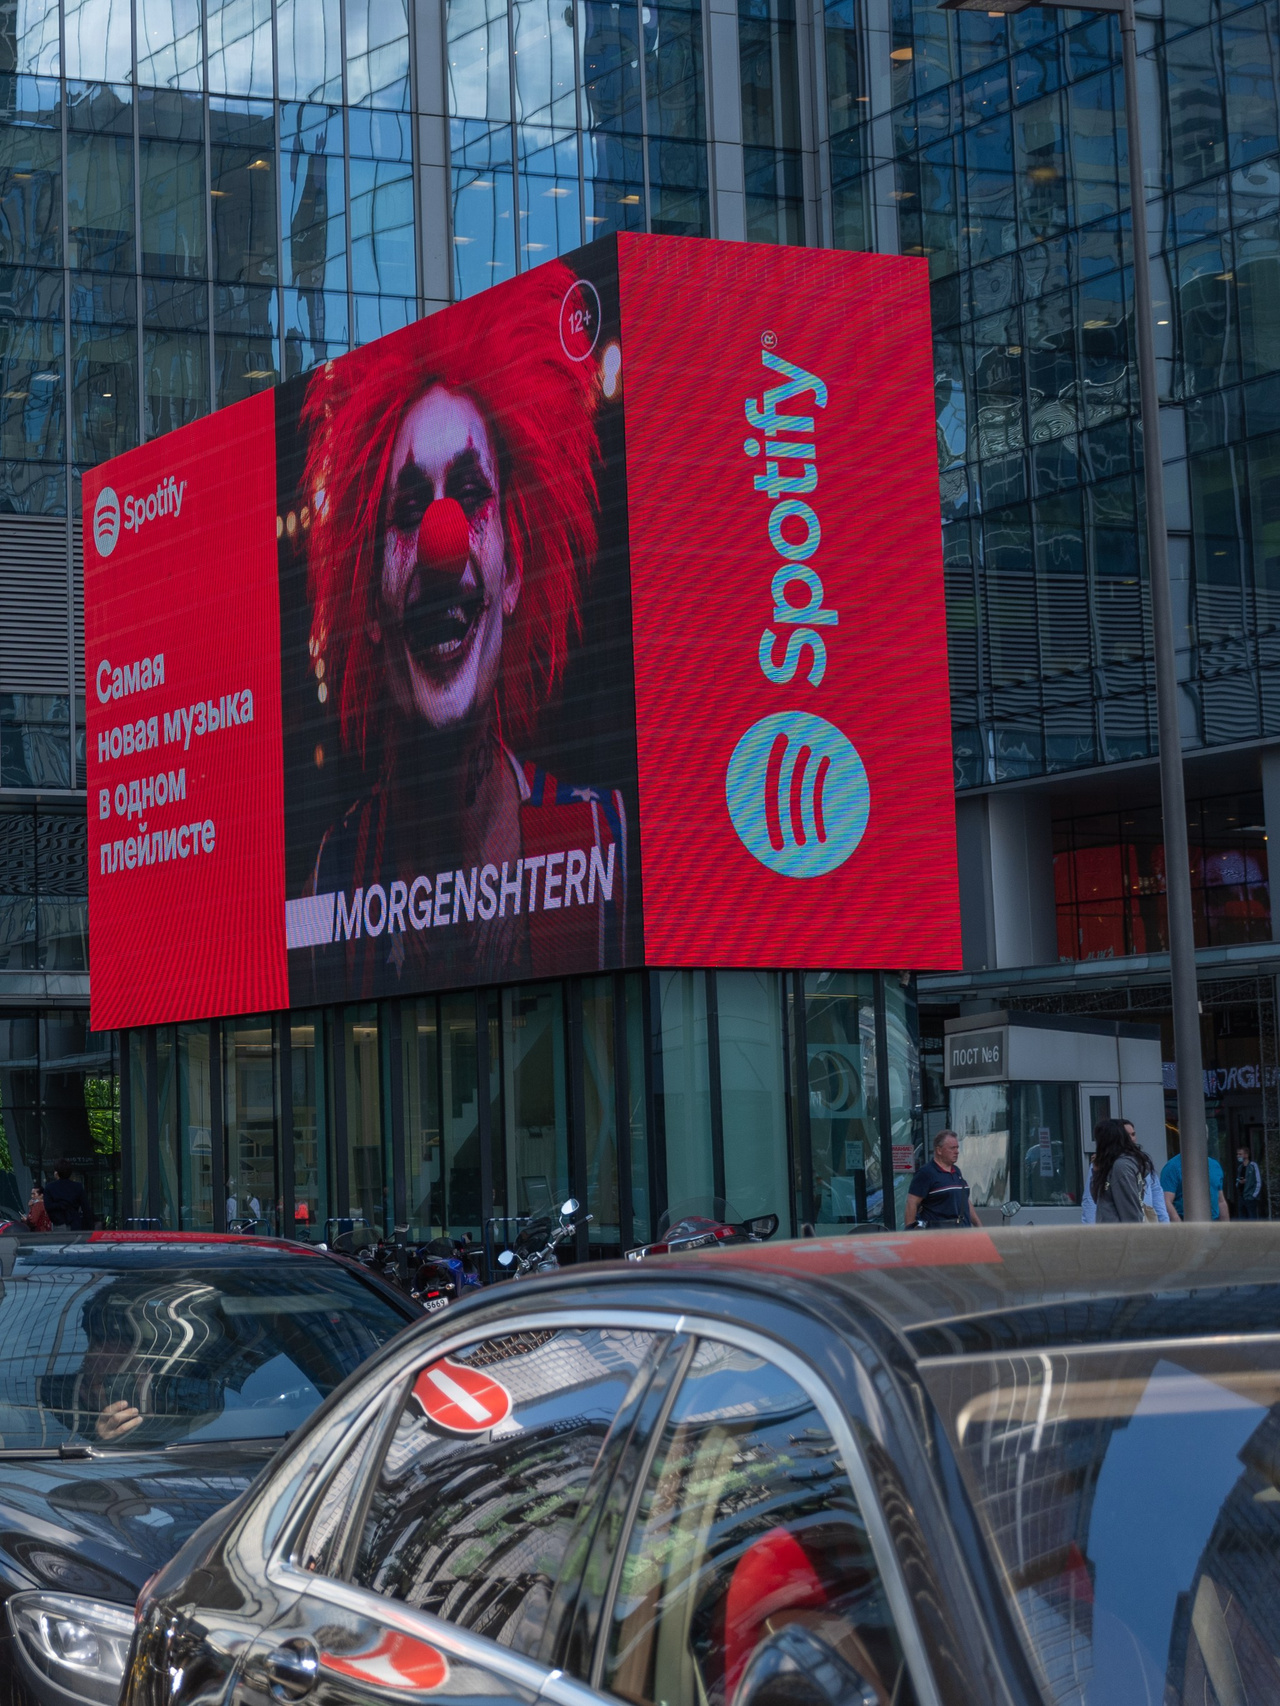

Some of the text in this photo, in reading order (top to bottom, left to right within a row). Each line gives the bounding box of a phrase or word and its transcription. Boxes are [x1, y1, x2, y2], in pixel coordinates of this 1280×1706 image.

[568, 309, 592, 335] 12+
[95, 652, 165, 705] Самая
[97, 687, 254, 763] новая музыка
[99, 767, 186, 820] в одном
[99, 817, 216, 876] плейлисте
[333, 843, 616, 943] MORGENSHTERN
[953, 1047, 979, 1067] ПОСТ
[426, 1299, 445, 1310] 5669
